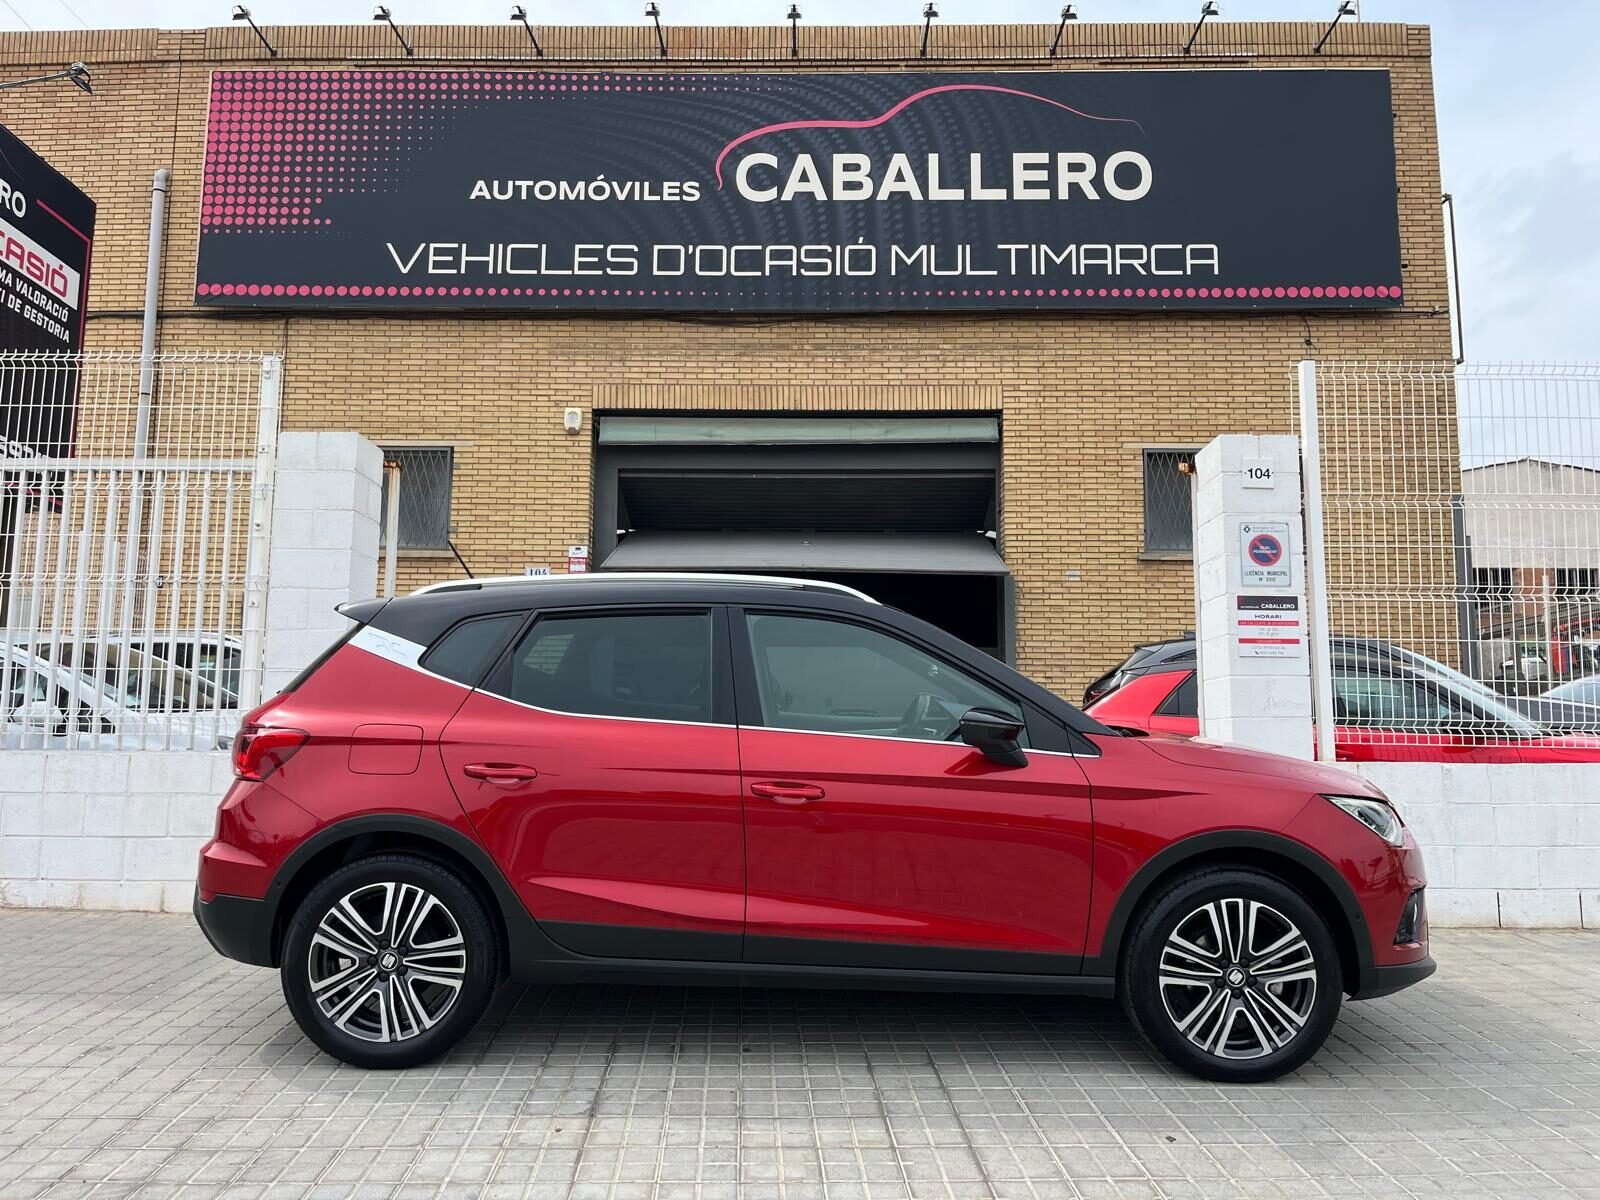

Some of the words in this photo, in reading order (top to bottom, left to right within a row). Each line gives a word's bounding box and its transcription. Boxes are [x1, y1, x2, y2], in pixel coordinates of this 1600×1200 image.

[470, 174, 701, 201] AUTOMÓVILES
[735, 151, 1153, 203] CABALLERO
[386, 243, 639, 276] VEHICLES
[652, 237, 877, 277] D'OCASIÓ
[8, 294, 22, 313] DE
[24, 305, 70, 343] GESTORIA
[16, 278, 69, 322] VALORACIÓ
[1247, 467, 1271, 479] 104
